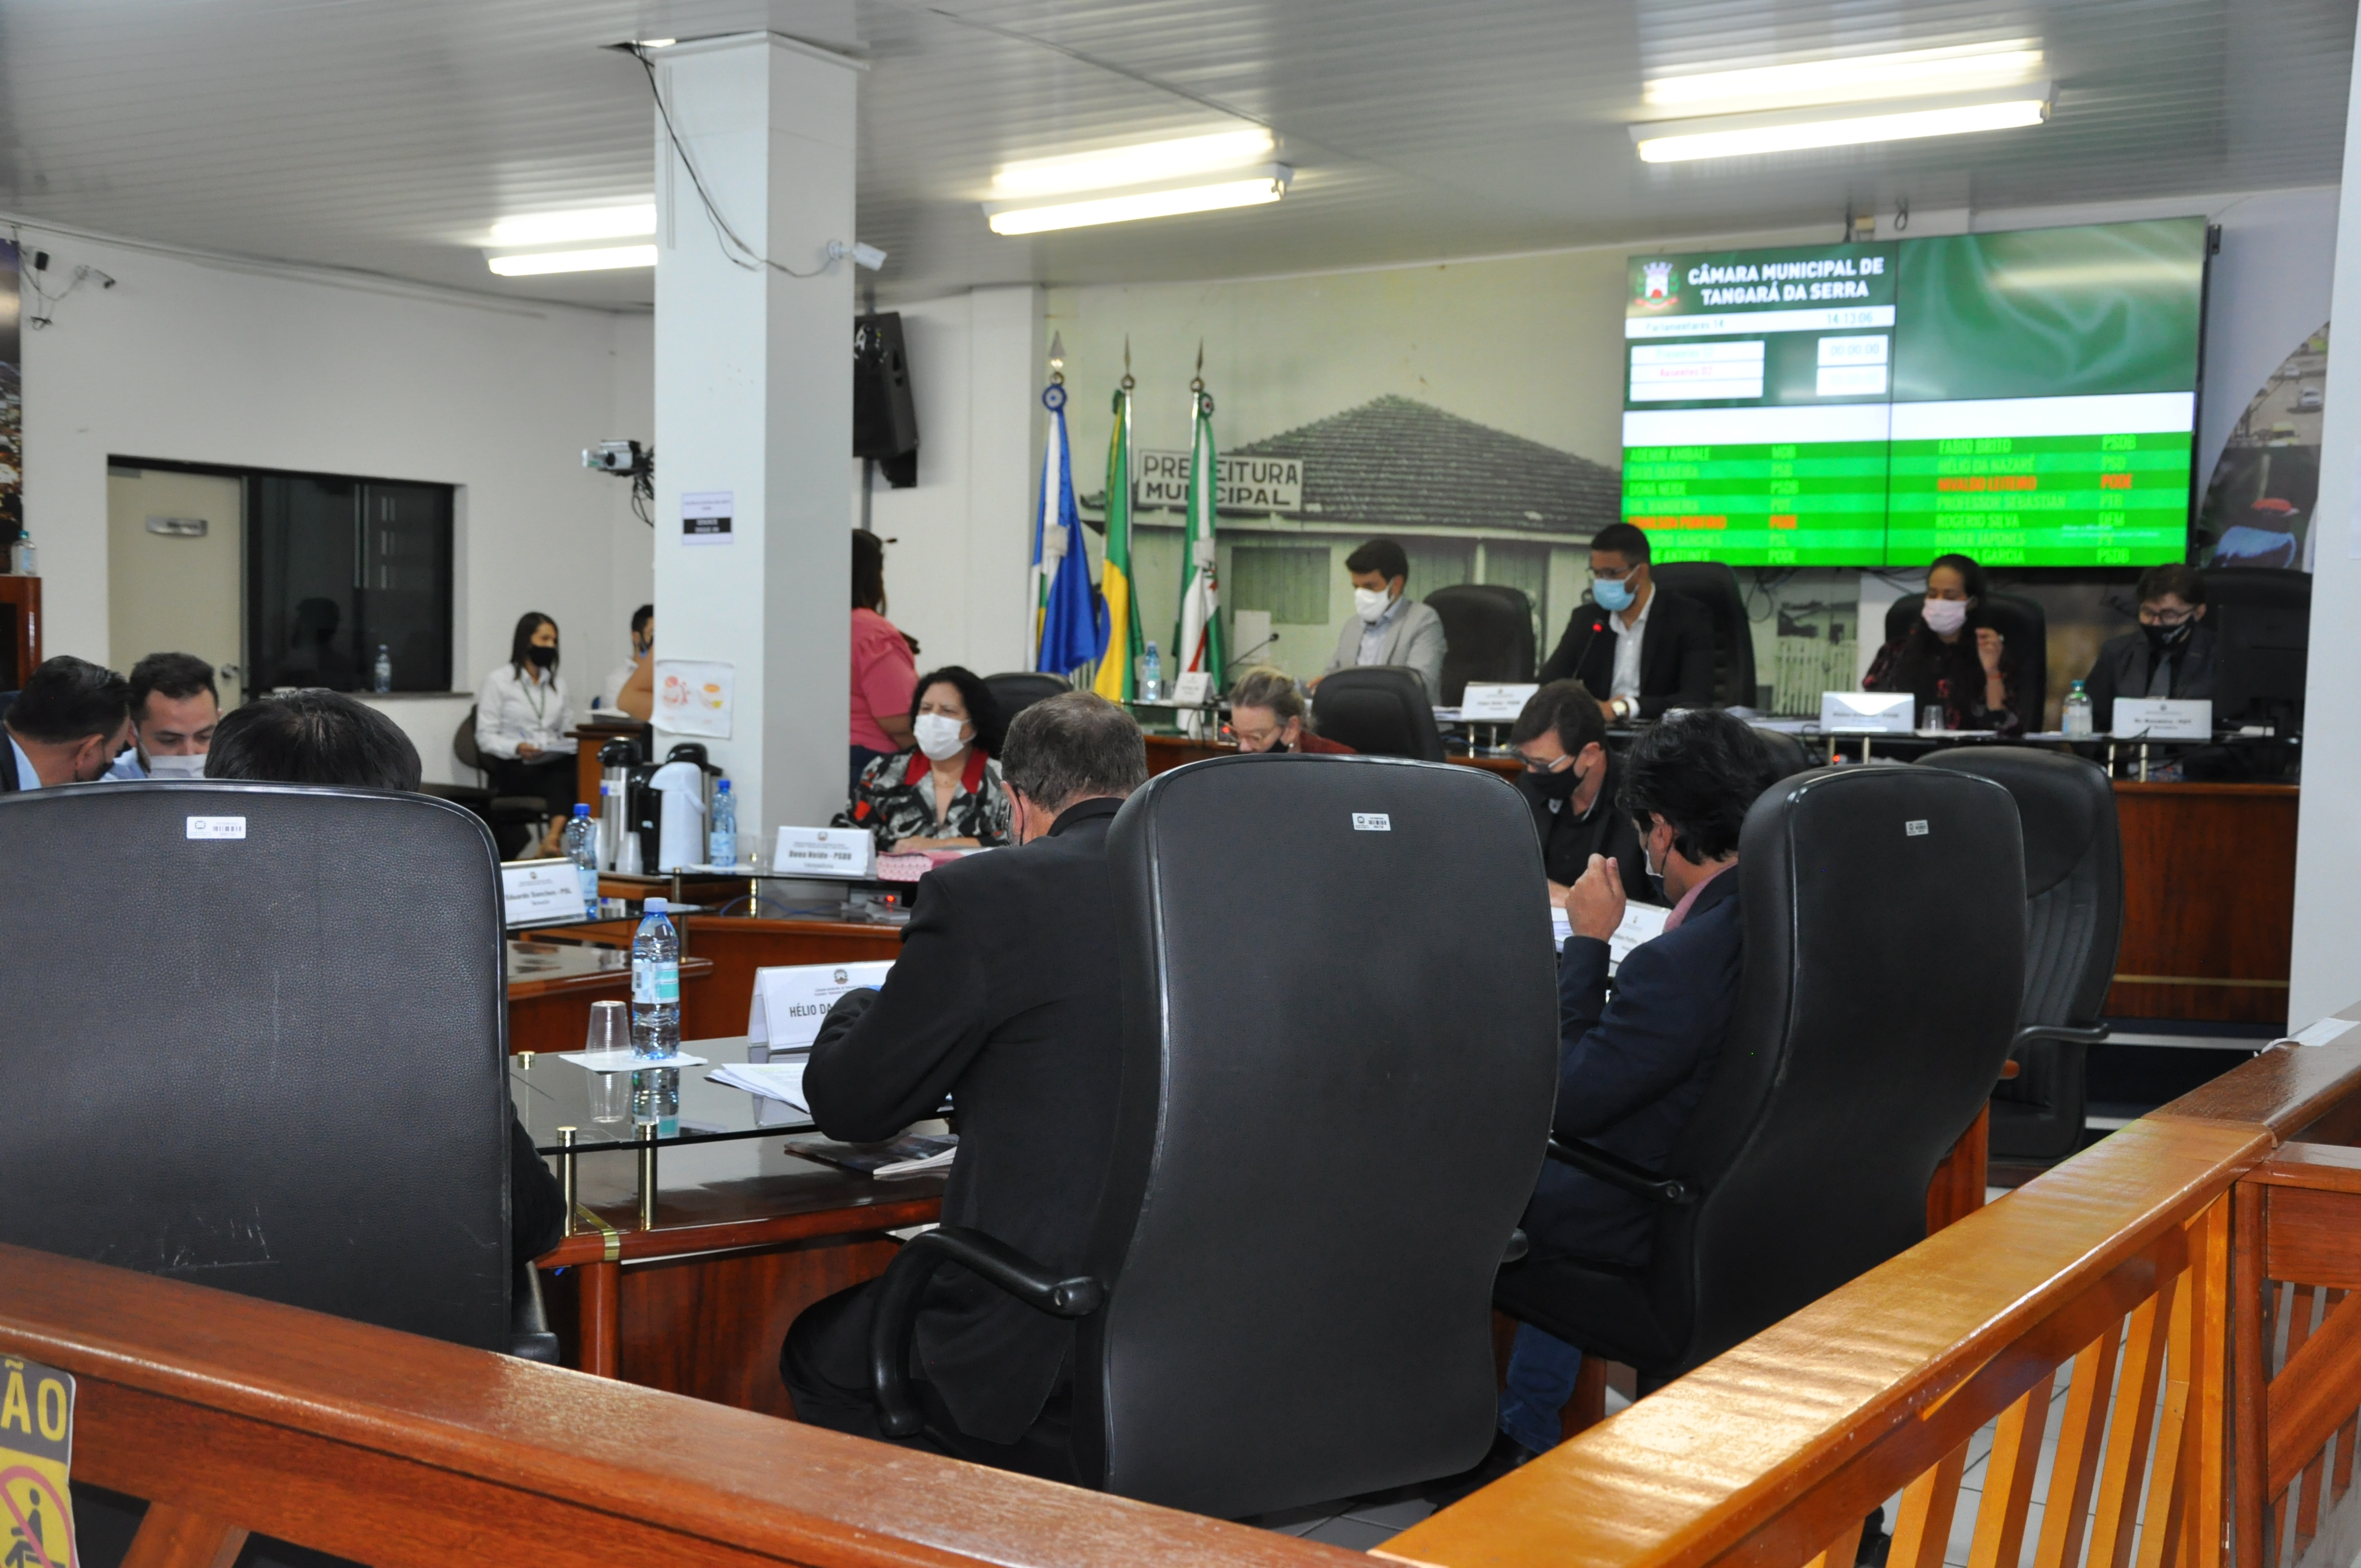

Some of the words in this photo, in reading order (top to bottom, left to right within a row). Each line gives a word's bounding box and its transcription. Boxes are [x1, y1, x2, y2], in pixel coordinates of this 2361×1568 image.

[1688, 263, 1759, 286] CÂMARA
[1762, 259, 1857, 281] MUNICIPAL
[1859, 257, 1885, 276] DE
[1700, 280, 1781, 306] TANGARÁ
[1782, 283, 1808, 302] DA
[1809, 280, 1869, 300] SERRA
[2102, 434, 2136, 450] PSDB
[1144, 455, 1298, 484] PREEITURA
[1145, 482, 1290, 505] MUCIPAL
[1987, 513, 2020, 528] SILVA
[790, 1003, 817, 1017] HÉLIO
